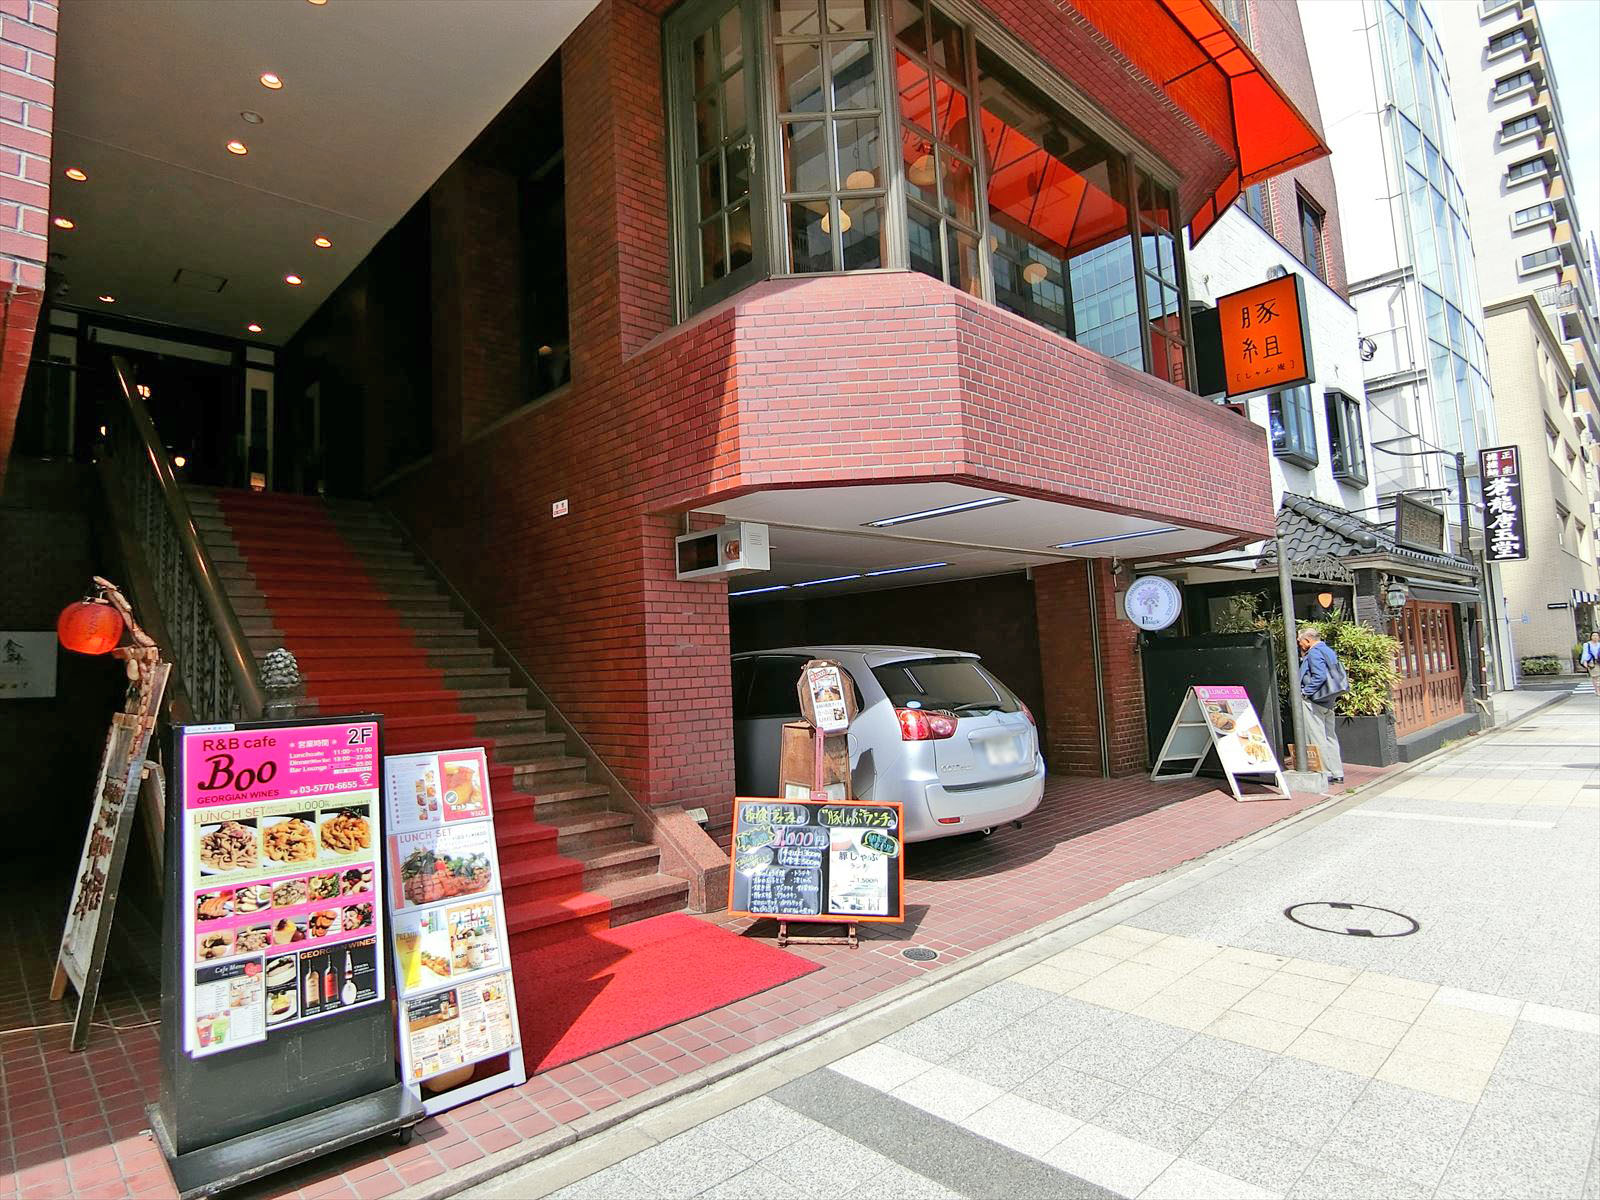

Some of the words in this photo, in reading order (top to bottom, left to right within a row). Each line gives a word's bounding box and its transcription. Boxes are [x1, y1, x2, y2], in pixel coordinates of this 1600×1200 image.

[203, 738, 240, 752] R&B
[243, 735, 277, 749] cafe
[347, 727, 373, 746] 2F
[197, 753, 277, 792] Boo
[300, 780, 358, 794] 03-5770-6655
[197, 792, 248, 805] GEORGIAN
[249, 789, 280, 799] WINES
[194, 810, 241, 825] LUNCH
[245, 806, 265, 818] SET
[400, 831, 432, 844] LUNCH
[435, 828, 452, 838] SET
[349, 937, 377, 950] WINES
